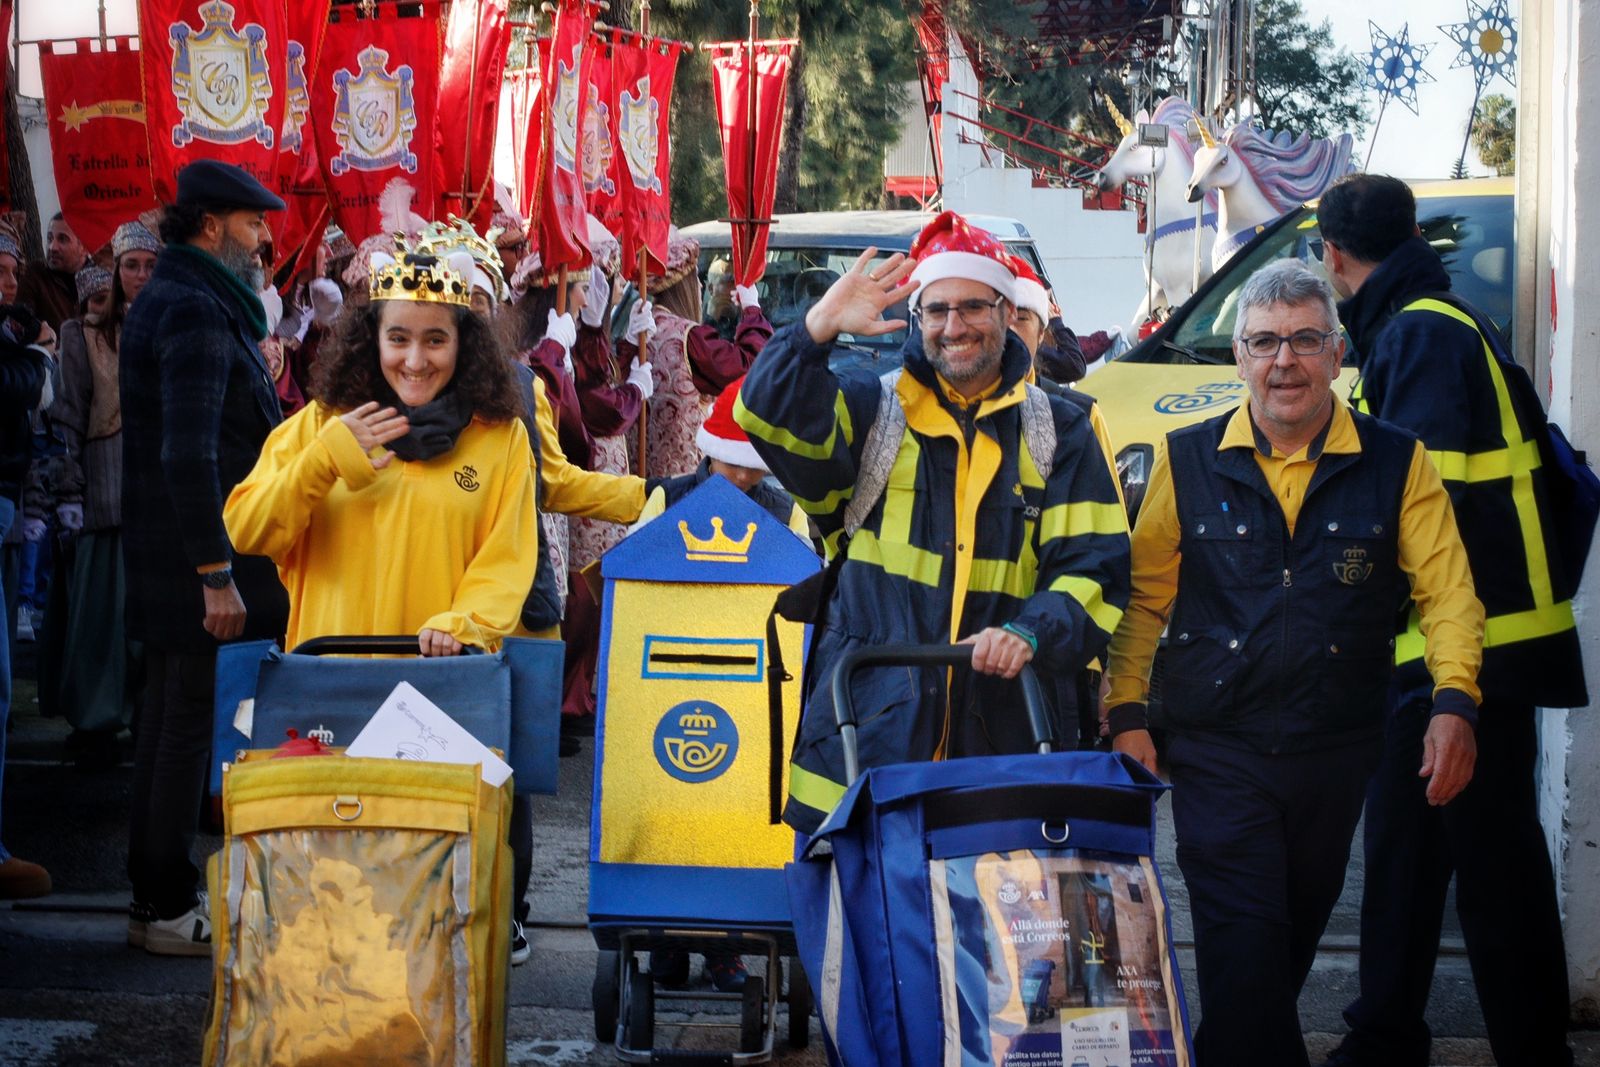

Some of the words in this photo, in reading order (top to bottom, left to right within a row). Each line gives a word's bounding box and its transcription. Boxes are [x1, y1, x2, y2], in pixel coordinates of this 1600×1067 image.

[68, 153, 128, 171] Estrella
[83, 182, 142, 200] Oriente
[1034, 917, 1070, 930] donde
[1026, 931, 1071, 943] Correos
[1116, 965, 1138, 976] AXA
[1117, 979, 1127, 989] te
[1129, 978, 1161, 991] protege
[1029, 1051, 1041, 1059] tus
[1041, 1050, 1060, 1059] datos
